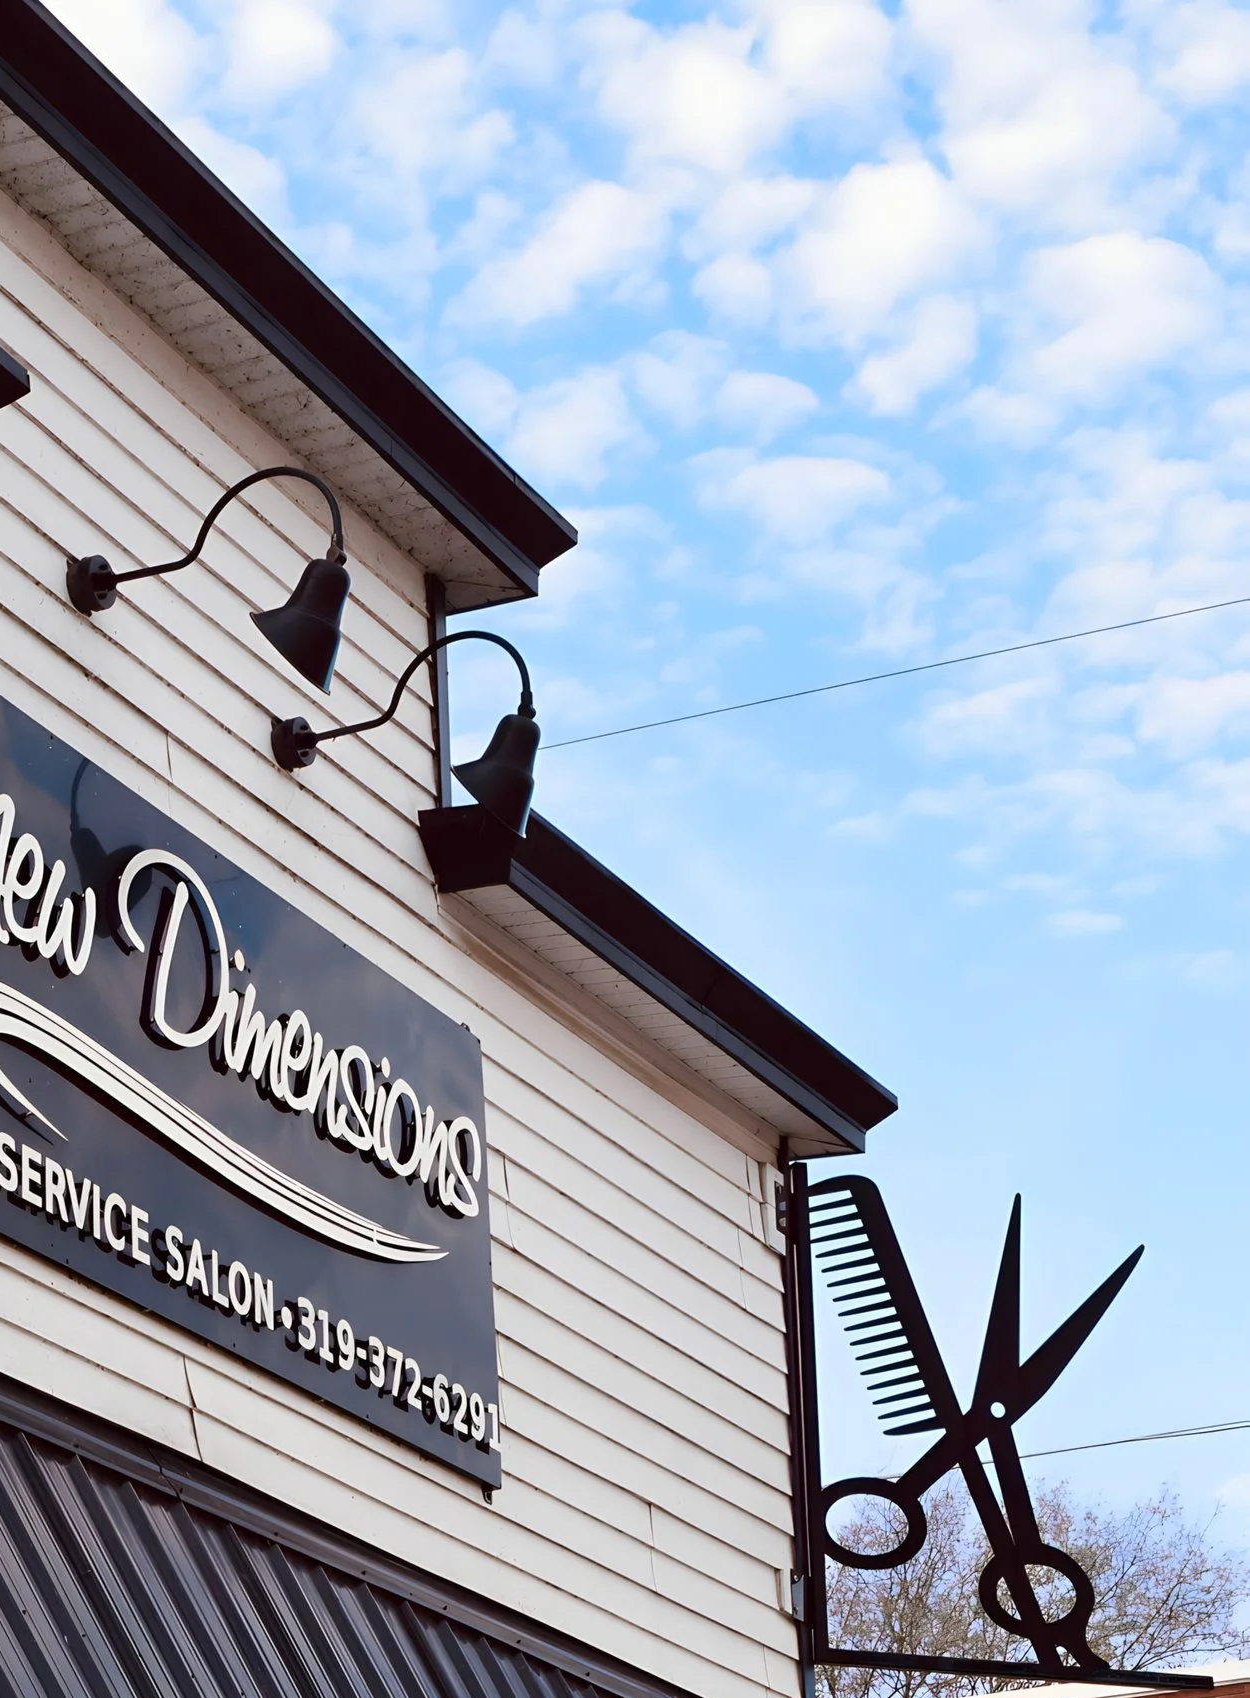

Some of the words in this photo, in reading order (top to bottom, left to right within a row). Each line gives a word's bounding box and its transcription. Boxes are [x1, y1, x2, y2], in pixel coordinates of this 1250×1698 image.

[117, 848, 482, 1218] Dimensions
[164, 1224, 275, 1331] SALON
[296, 1295, 501, 1453] 319-372-6291
